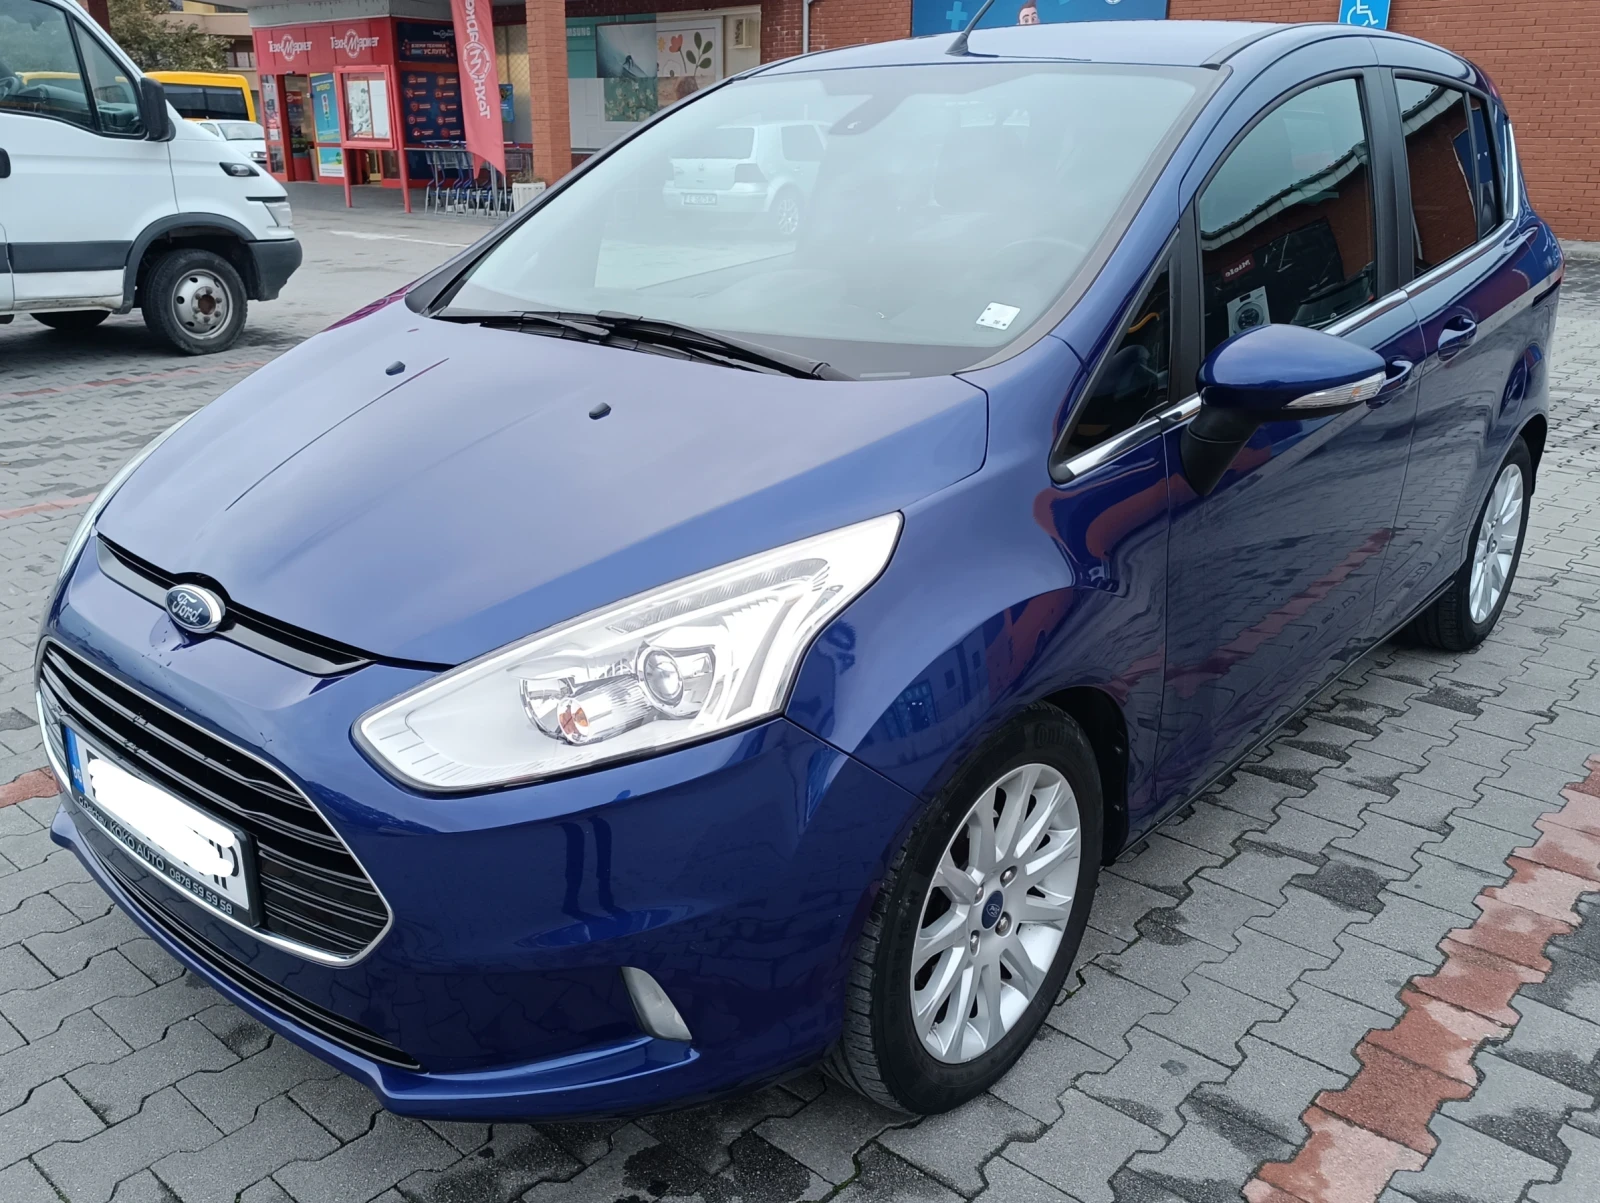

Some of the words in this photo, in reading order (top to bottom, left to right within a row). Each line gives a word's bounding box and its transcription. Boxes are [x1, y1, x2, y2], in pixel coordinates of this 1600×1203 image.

[171, 592, 203, 623] Ford
[72, 763, 83, 783] BG
[109, 818, 135, 850] KOKO
[137, 844, 165, 871] AUTO
[169, 867, 191, 889] 0878
[192, 883, 204, 898] 59
[206, 890, 218, 906] 59
[220, 899, 233, 915] 58
